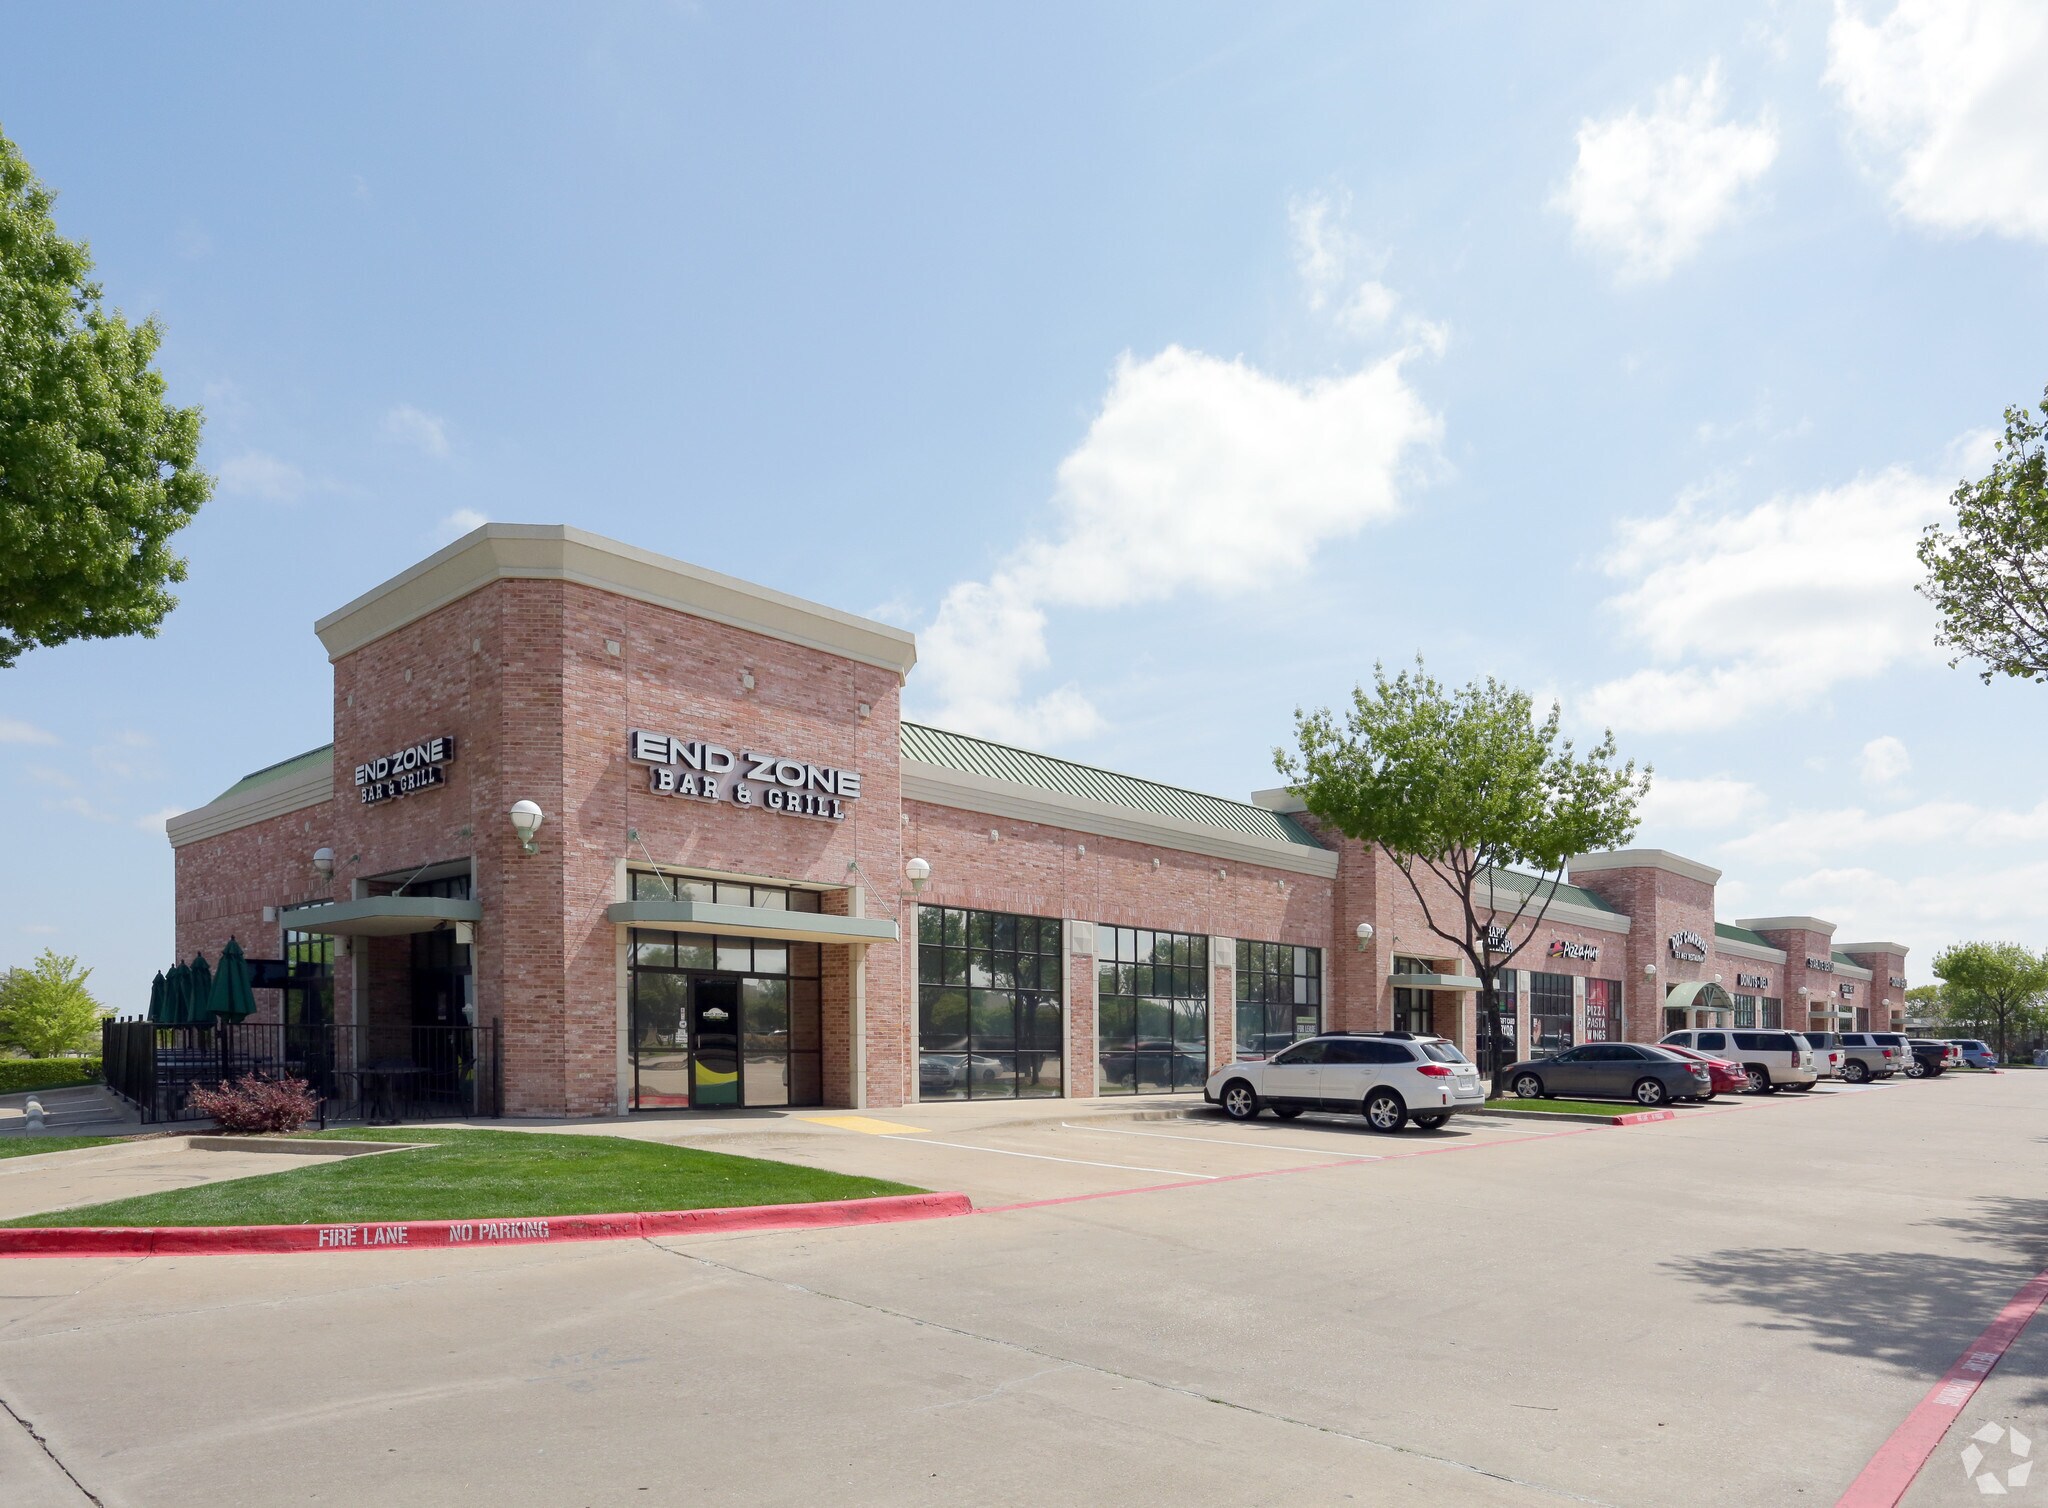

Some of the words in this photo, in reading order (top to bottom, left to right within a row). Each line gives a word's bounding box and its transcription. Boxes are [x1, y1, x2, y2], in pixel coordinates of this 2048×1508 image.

[355, 757, 389, 787] END
[392, 737, 444, 775] ZONE
[636, 730, 736, 774] END
[746, 753, 861, 798] ZONE
[361, 783, 383, 804] BAR
[388, 780, 395, 795] &
[400, 766, 436, 792] GRILL
[657, 767, 720, 799] BAR
[736, 782, 752, 804] &
[766, 788, 845, 819] GRILL
[1672, 931, 1683, 950] DOS
[1586, 1005, 1606, 1017] PIZZA
[1586, 1017, 1606, 1028] PASTA
[1586, 1029, 1606, 1041] WINGS
[318, 1226, 357, 1247] FIRE
[363, 1226, 408, 1246] LANE
[450, 1224, 473, 1242] NO
[478, 1221, 549, 1240] PARKING
